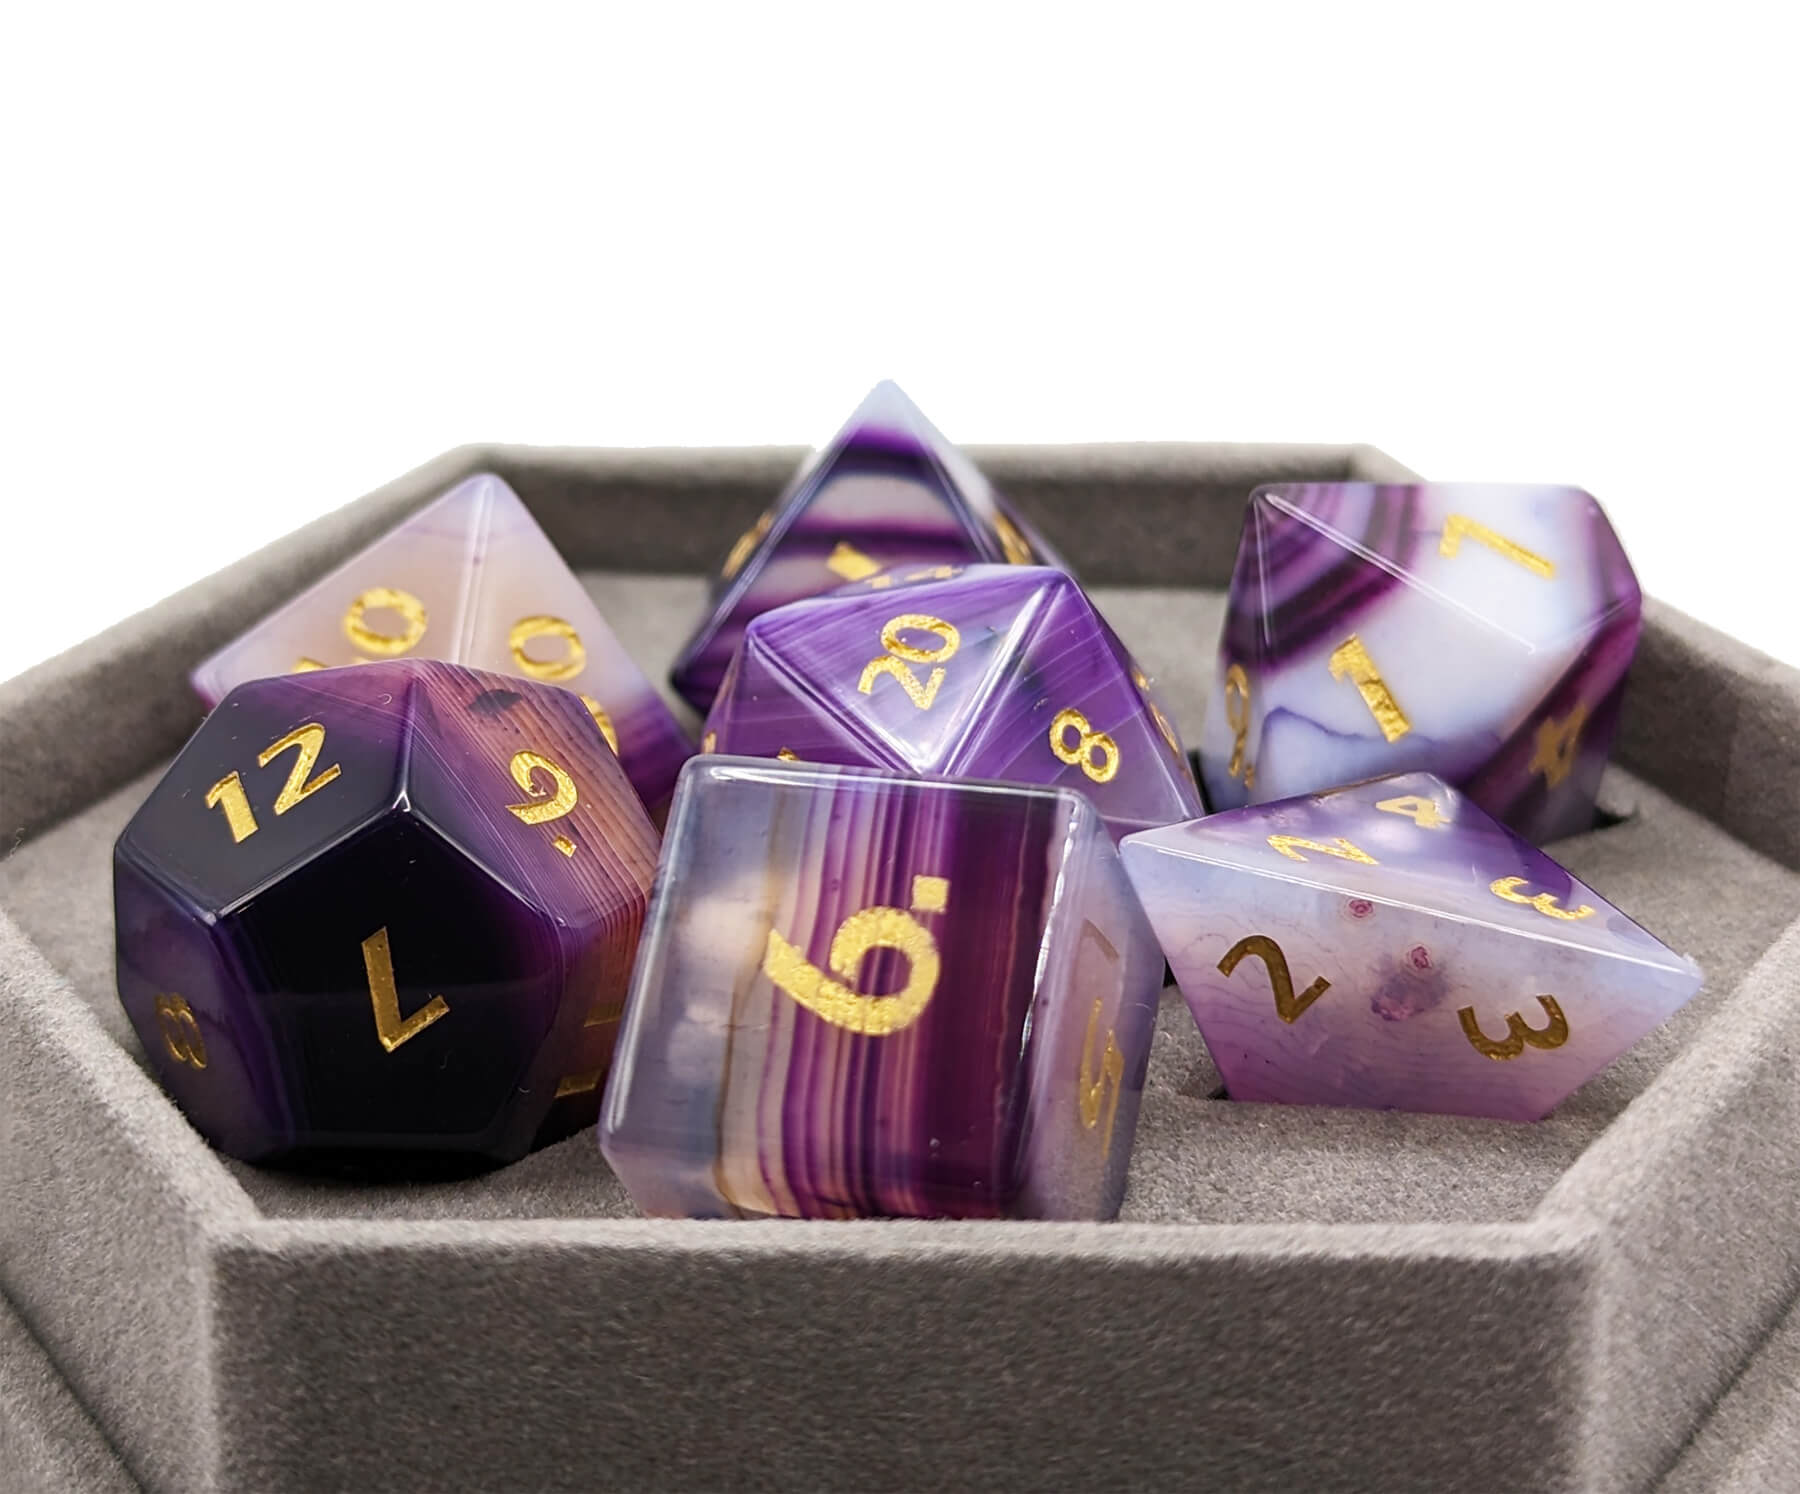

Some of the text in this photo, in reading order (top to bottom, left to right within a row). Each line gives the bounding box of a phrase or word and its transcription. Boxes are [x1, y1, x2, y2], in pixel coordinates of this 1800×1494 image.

[857, 614, 960, 711] 20
[1328, 633, 1412, 743] 1
[205, 722, 341, 843] 12
[1049, 708, 1119, 783] 8
[1266, 834, 1380, 866] 2
[1376, 795, 1452, 829] 4
[1489, 876, 1597, 920] 3
[361, 926, 450, 1053] 7
[1217, 934, 1332, 1025] 2
[1457, 994, 1570, 1061] 3
